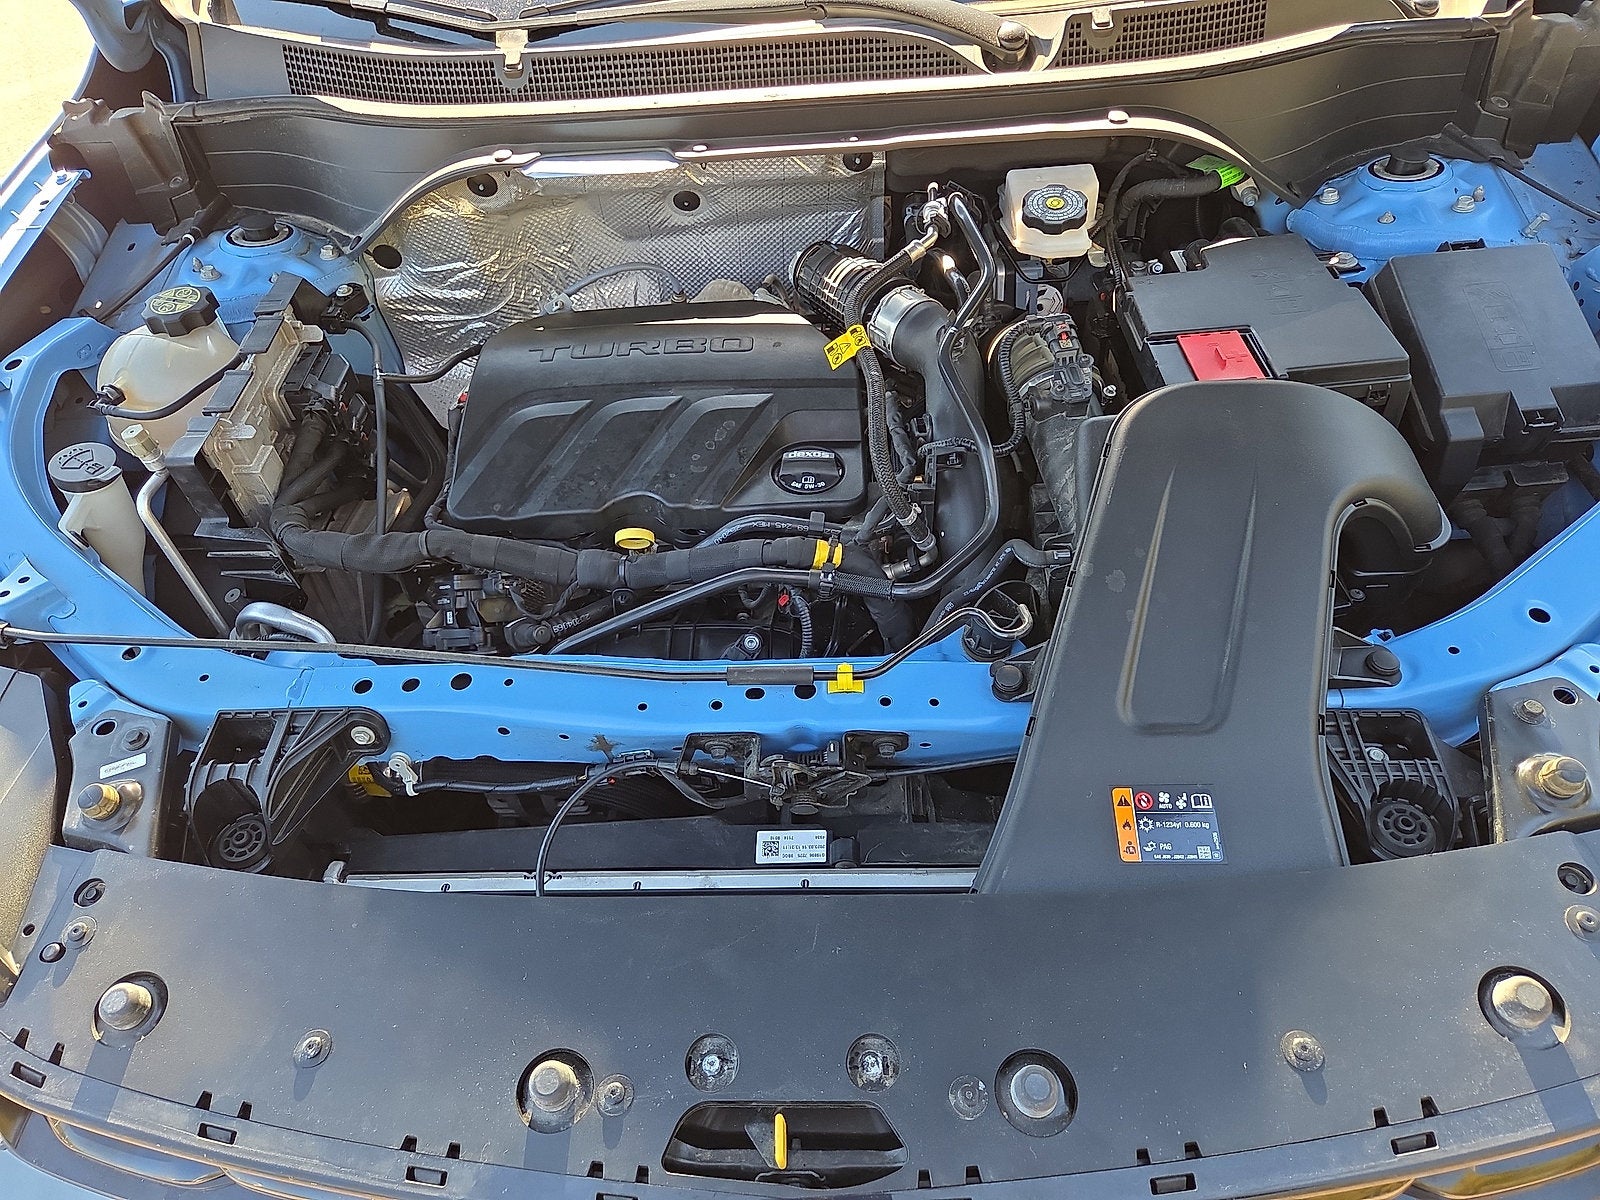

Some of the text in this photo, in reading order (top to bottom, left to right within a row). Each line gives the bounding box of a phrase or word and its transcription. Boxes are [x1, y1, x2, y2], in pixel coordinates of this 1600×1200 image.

[528, 336, 754, 363] TURBO
[788, 450, 830, 459] dexos
[804, 481, 826, 490] 5W-30
